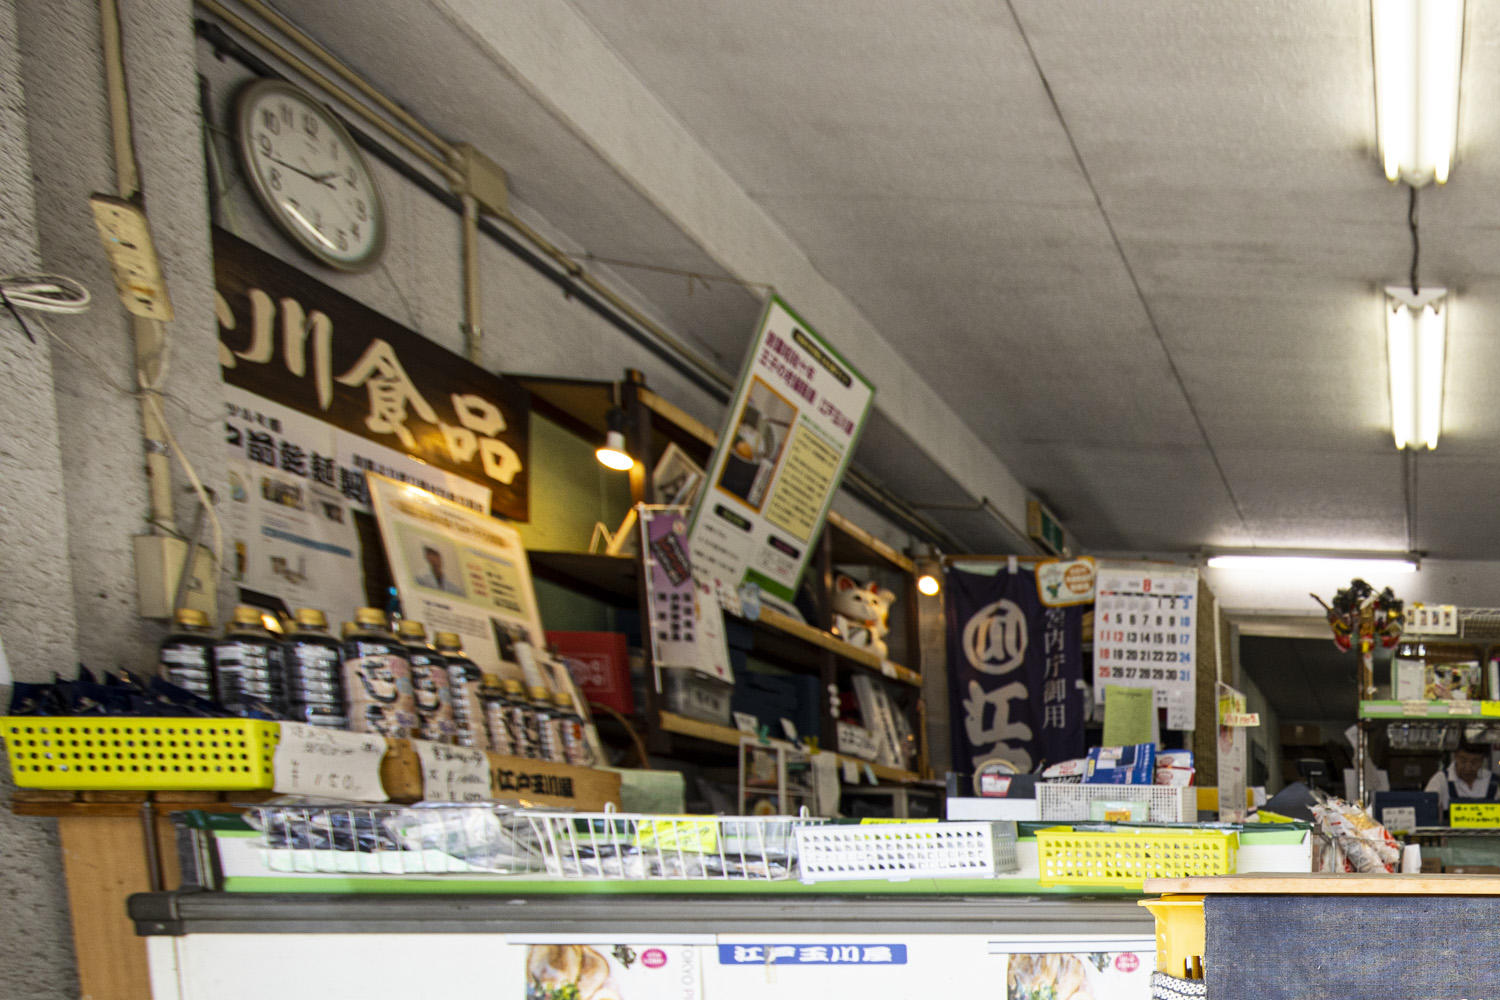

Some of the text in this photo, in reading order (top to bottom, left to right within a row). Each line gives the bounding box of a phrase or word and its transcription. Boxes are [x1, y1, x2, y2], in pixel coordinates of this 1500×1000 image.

[734, 944, 892, 963] 江戸玉川屋
